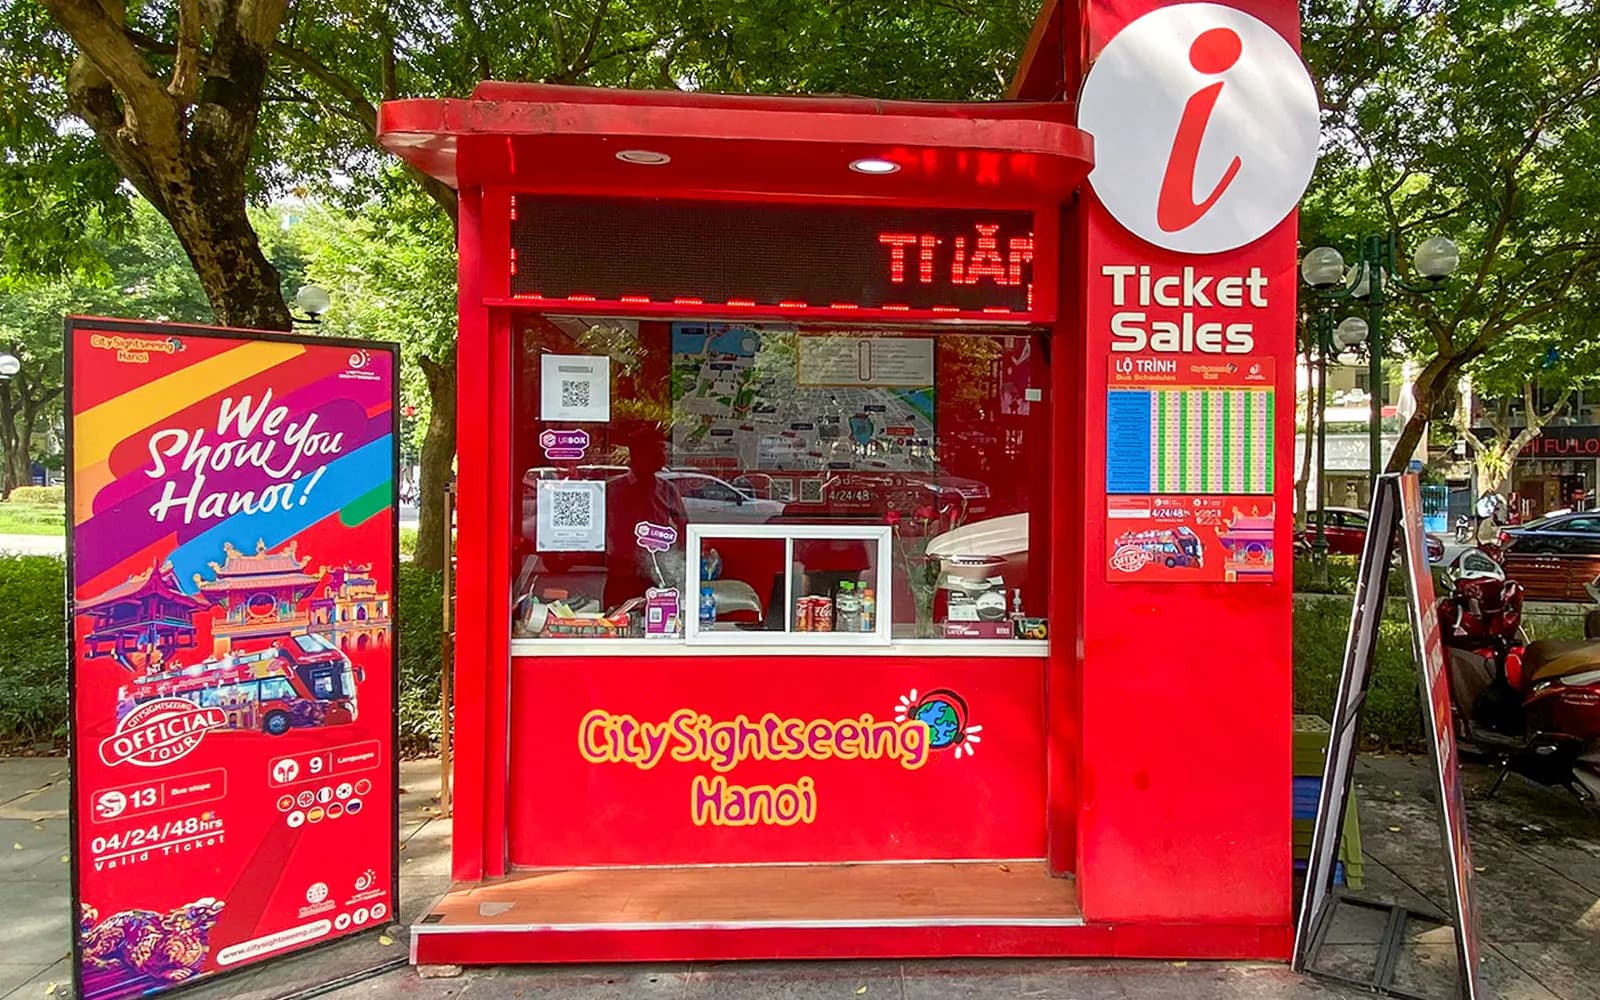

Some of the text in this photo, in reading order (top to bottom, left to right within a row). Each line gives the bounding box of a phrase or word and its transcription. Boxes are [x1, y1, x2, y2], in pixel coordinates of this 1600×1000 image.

[1102, 265, 1268, 307] Ticket
[1111, 312, 1255, 353] Sales
[117, 350, 149, 363] Hanoi
[1116, 357, 1133, 374] LỘ
[1136, 357, 1177, 373] TRÌNH
[217, 387, 288, 436] We
[145, 413, 344, 479] Show You
[149, 465, 327, 524] Hanoi!
[113, 711, 222, 757] OFFICIAL
[127, 702, 193, 728] CITYSIGHTSEEING
[150, 735, 197, 760] TOUR
[579, 709, 930, 770] CitySightseeing
[309, 757, 323, 773] 9
[129, 788, 157, 808] 13
[692, 776, 817, 826] Hanoi
[94, 834, 224, 871] Valid Ticket
